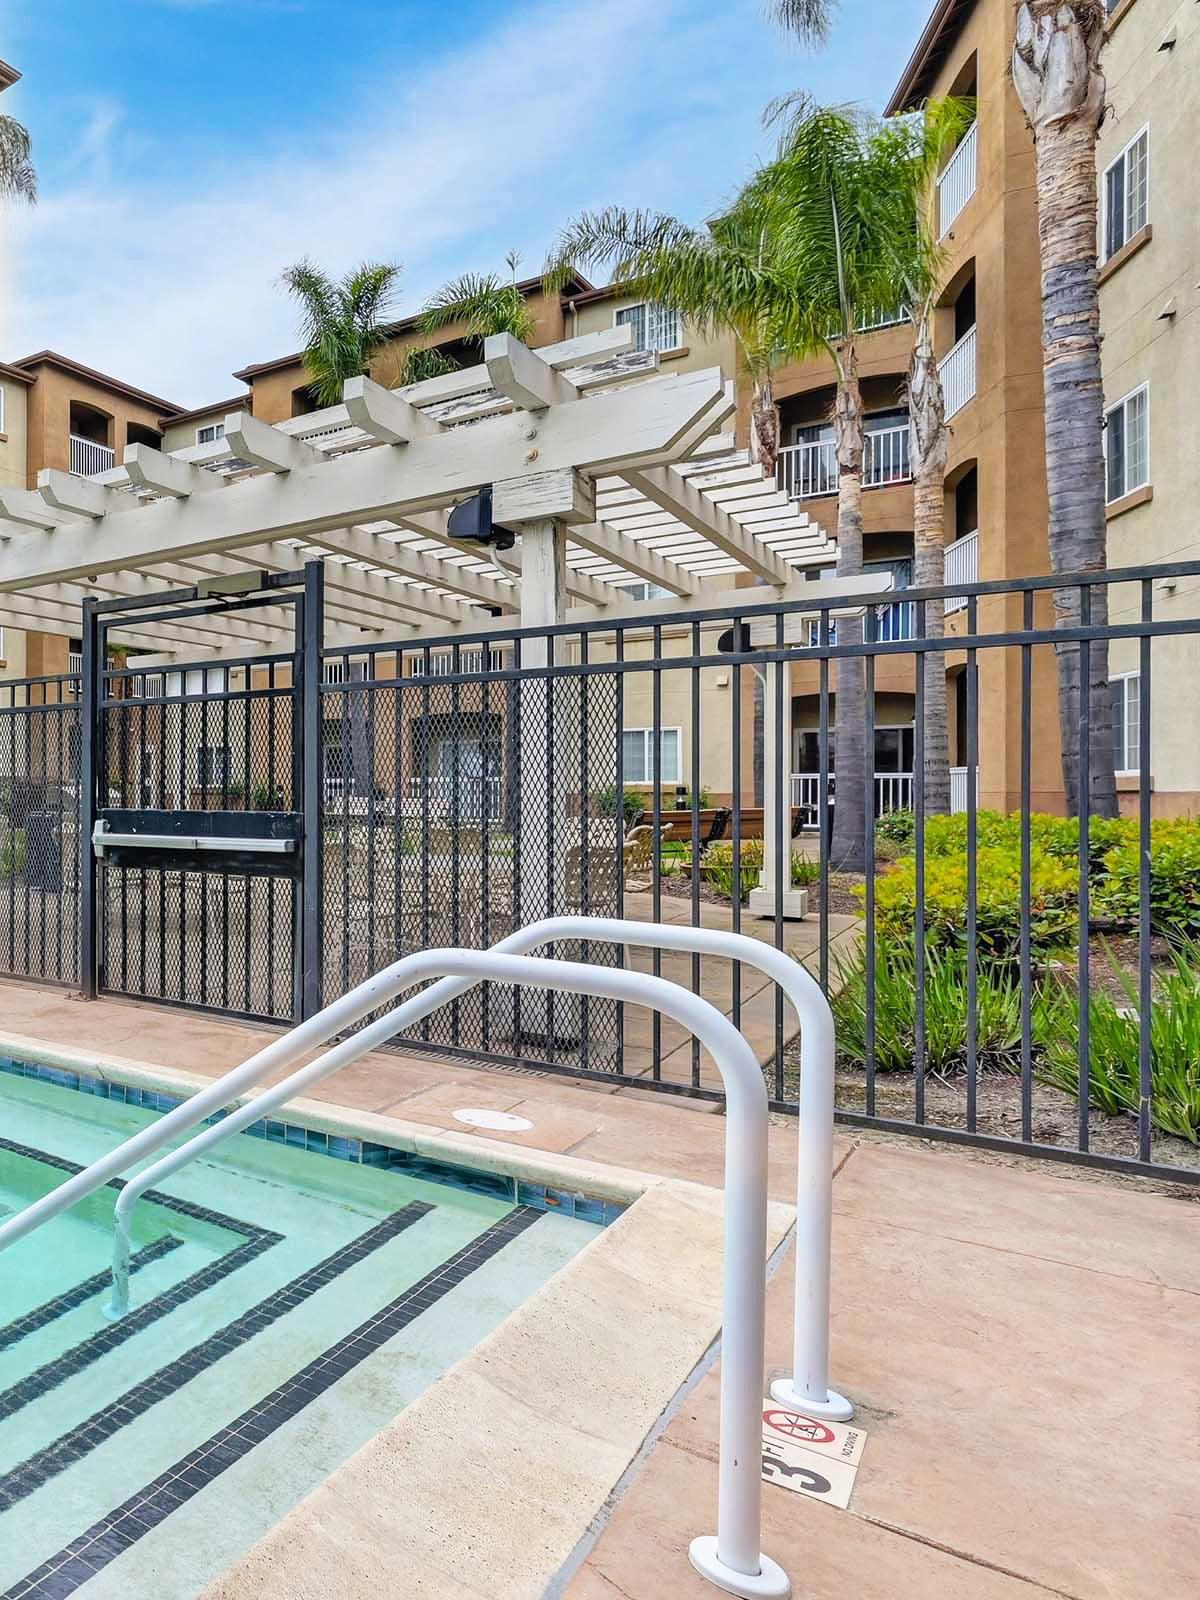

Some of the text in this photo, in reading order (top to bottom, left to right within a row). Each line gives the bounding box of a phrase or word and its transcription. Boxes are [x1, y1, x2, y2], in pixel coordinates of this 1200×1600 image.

[841, 1431, 859, 1458] NO DIVING
[761, 1455, 831, 1493] 3
